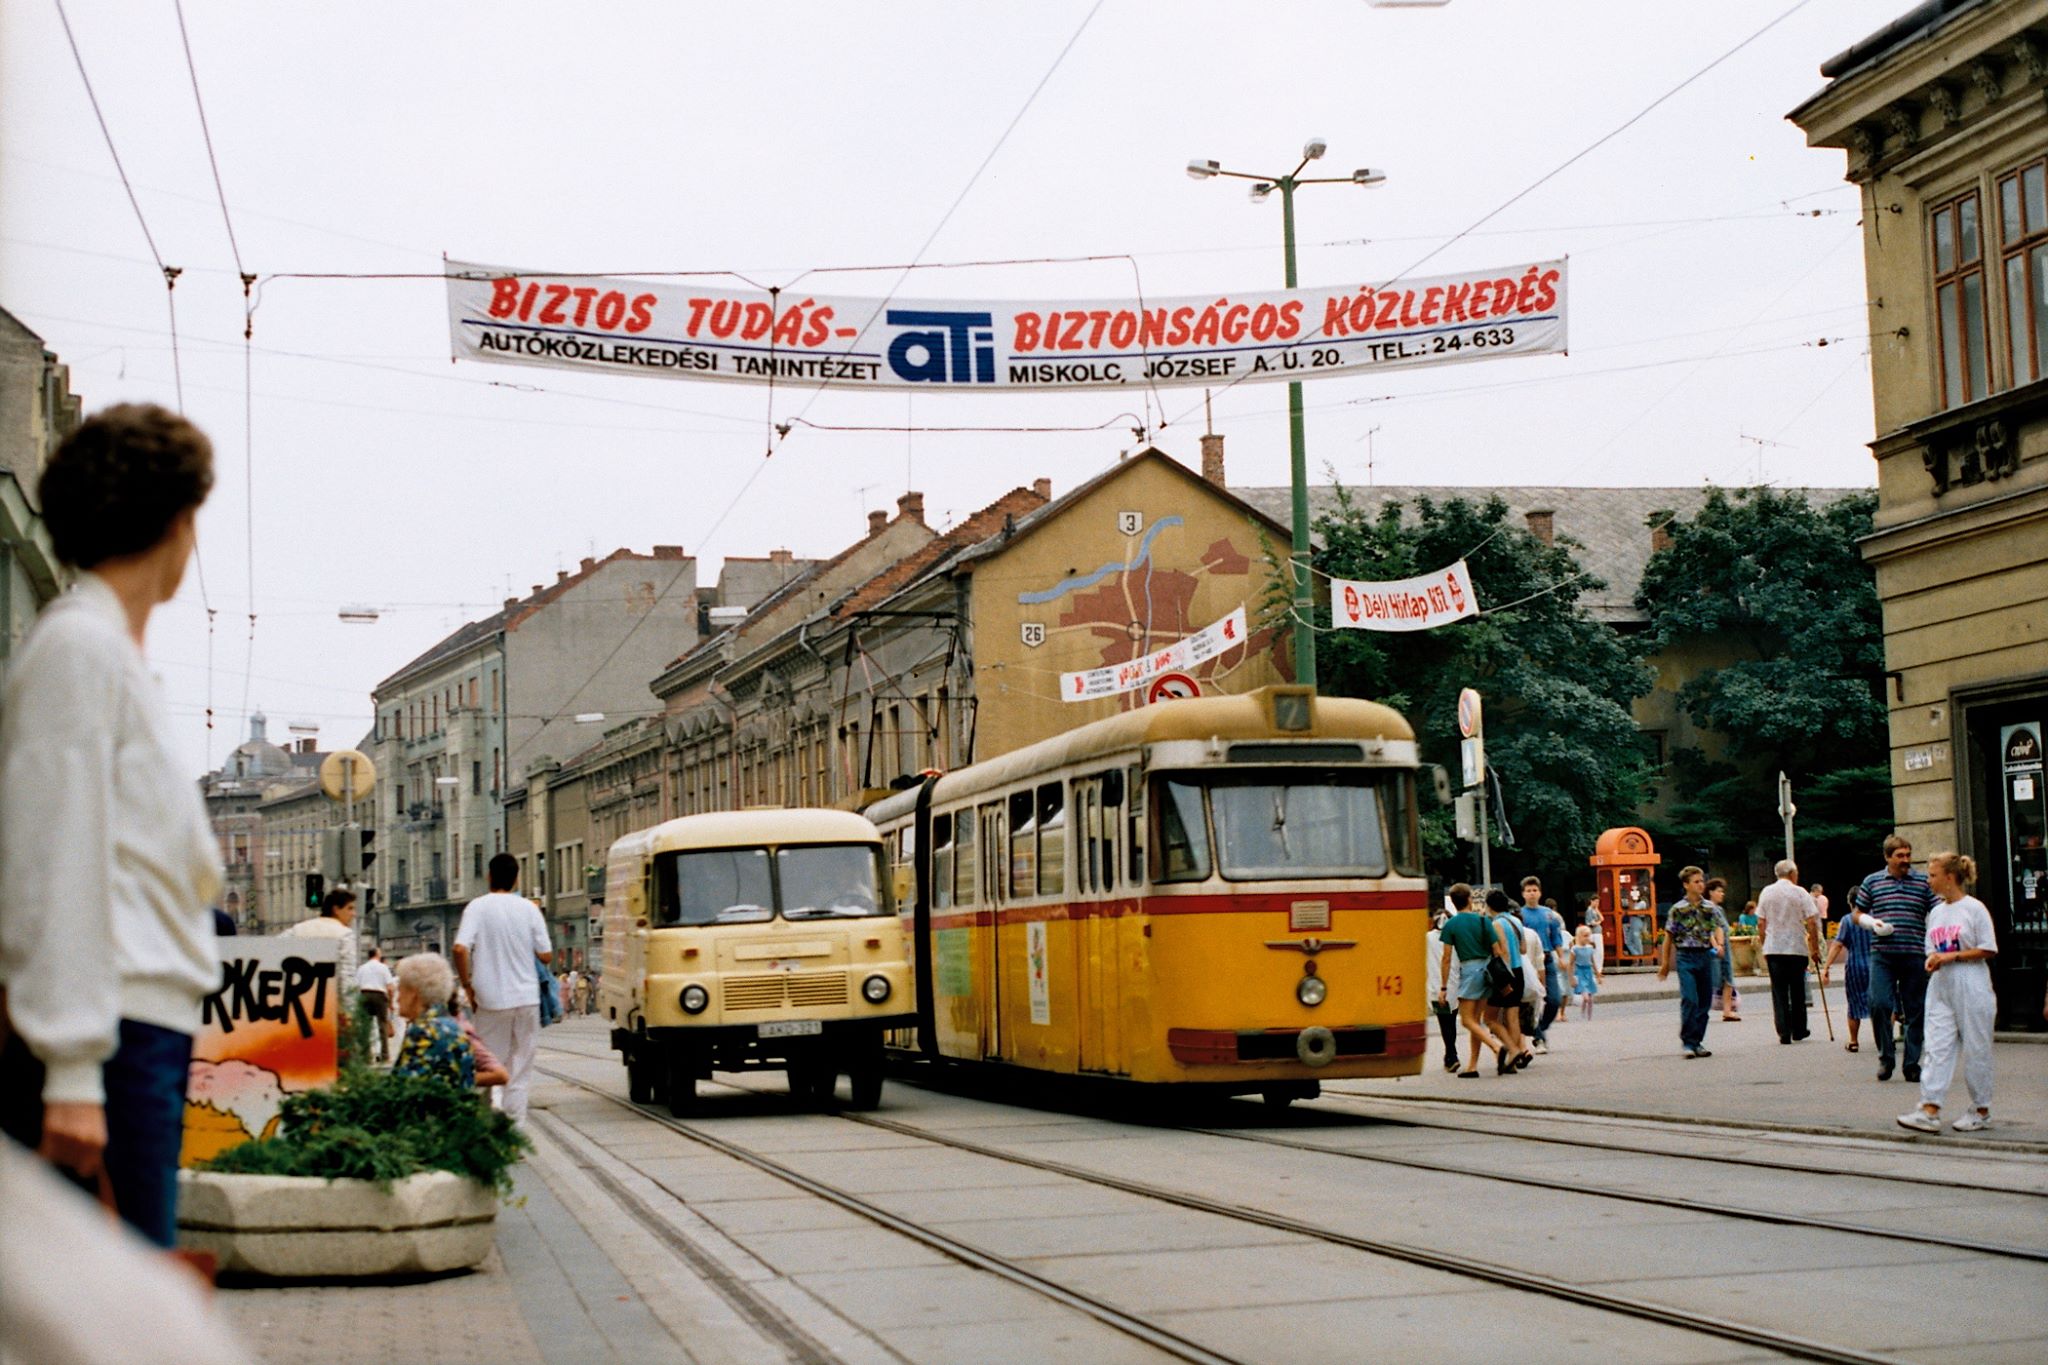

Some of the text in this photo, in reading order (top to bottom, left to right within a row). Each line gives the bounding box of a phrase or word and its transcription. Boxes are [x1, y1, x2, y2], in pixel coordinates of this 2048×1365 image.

[488, 276, 857, 348] BIZTOS TUDÁS-
[1013, 265, 1560, 353] BIZTONSÁGOS KÖZLEKEDÉS
[479, 330, 882, 381] AUTÓKÖZLEKEDÉSI TANINTÉZET
[1009, 328, 1515, 384] MISKOLC, JÓZSEF A. U. 20. TEL.: 24-633
[1126, 514, 1136, 532] 3
[1363, 592, 1390, 619] Déli
[1426, 584, 1450, 614] Kft
[1025, 626, 1041, 642] 26
[1376, 975, 1403, 997] 143
